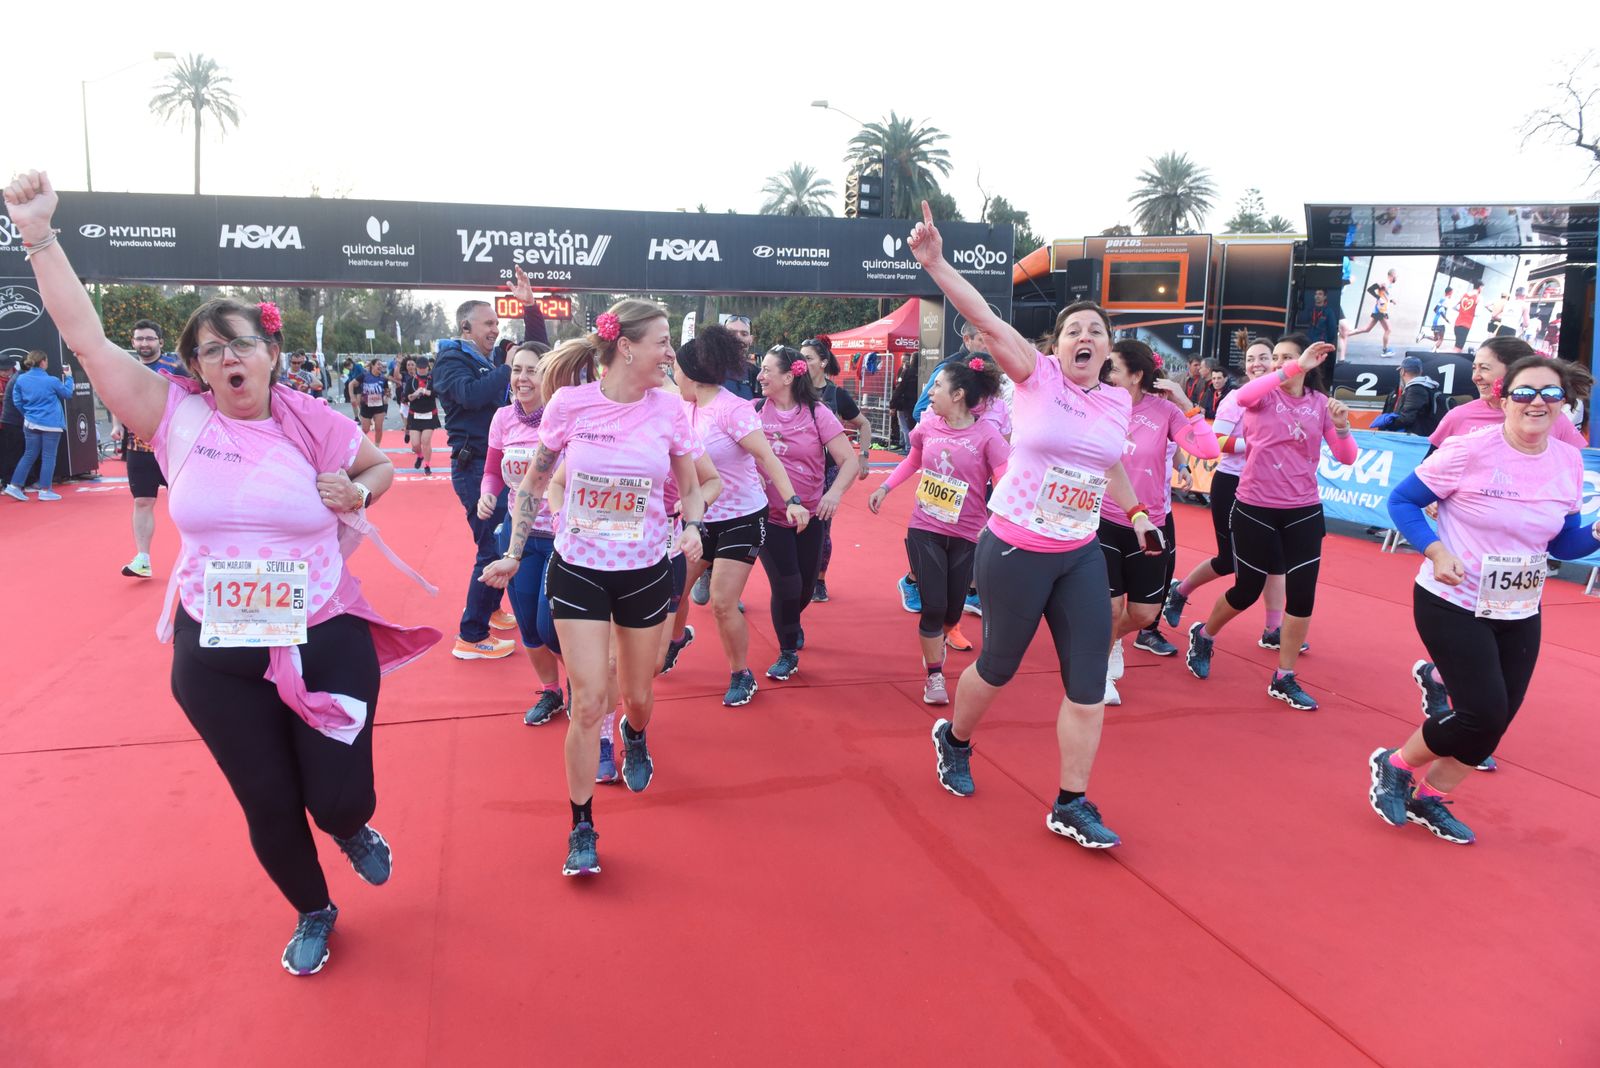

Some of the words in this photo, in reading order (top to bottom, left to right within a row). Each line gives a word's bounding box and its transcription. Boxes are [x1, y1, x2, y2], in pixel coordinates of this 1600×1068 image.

[110, 227, 176, 238] HYUNDAI
[219, 224, 302, 250] HOKA
[486, 229, 589, 249] maratón
[110, 239, 152, 248] Hyundauto
[153, 239, 176, 248] Motor
[649, 239, 721, 262] HOKA
[777, 248, 830, 259] HYUNDAI
[1105, 239, 1142, 249] portos
[348, 259, 384, 267] Healthcare
[776, 258, 810, 267] Hyundauto
[500, 269, 513, 279] 28
[515, 271, 545, 280] ero
[547, 270, 572, 281] 2024
[1355, 372, 1379, 397] 2
[1437, 363, 1456, 395] 1
[505, 459, 529, 476] 137
[576, 487, 636, 512] 13713
[923, 479, 957, 503] 10067
[1047, 481, 1096, 511] 13705
[1317, 485, 1359, 506] UMAN
[1358, 493, 1384, 509] FLY
[266, 560, 295, 573] SEVILLA
[1488, 568, 1541, 591] 15436
[212, 581, 292, 608] 13712
